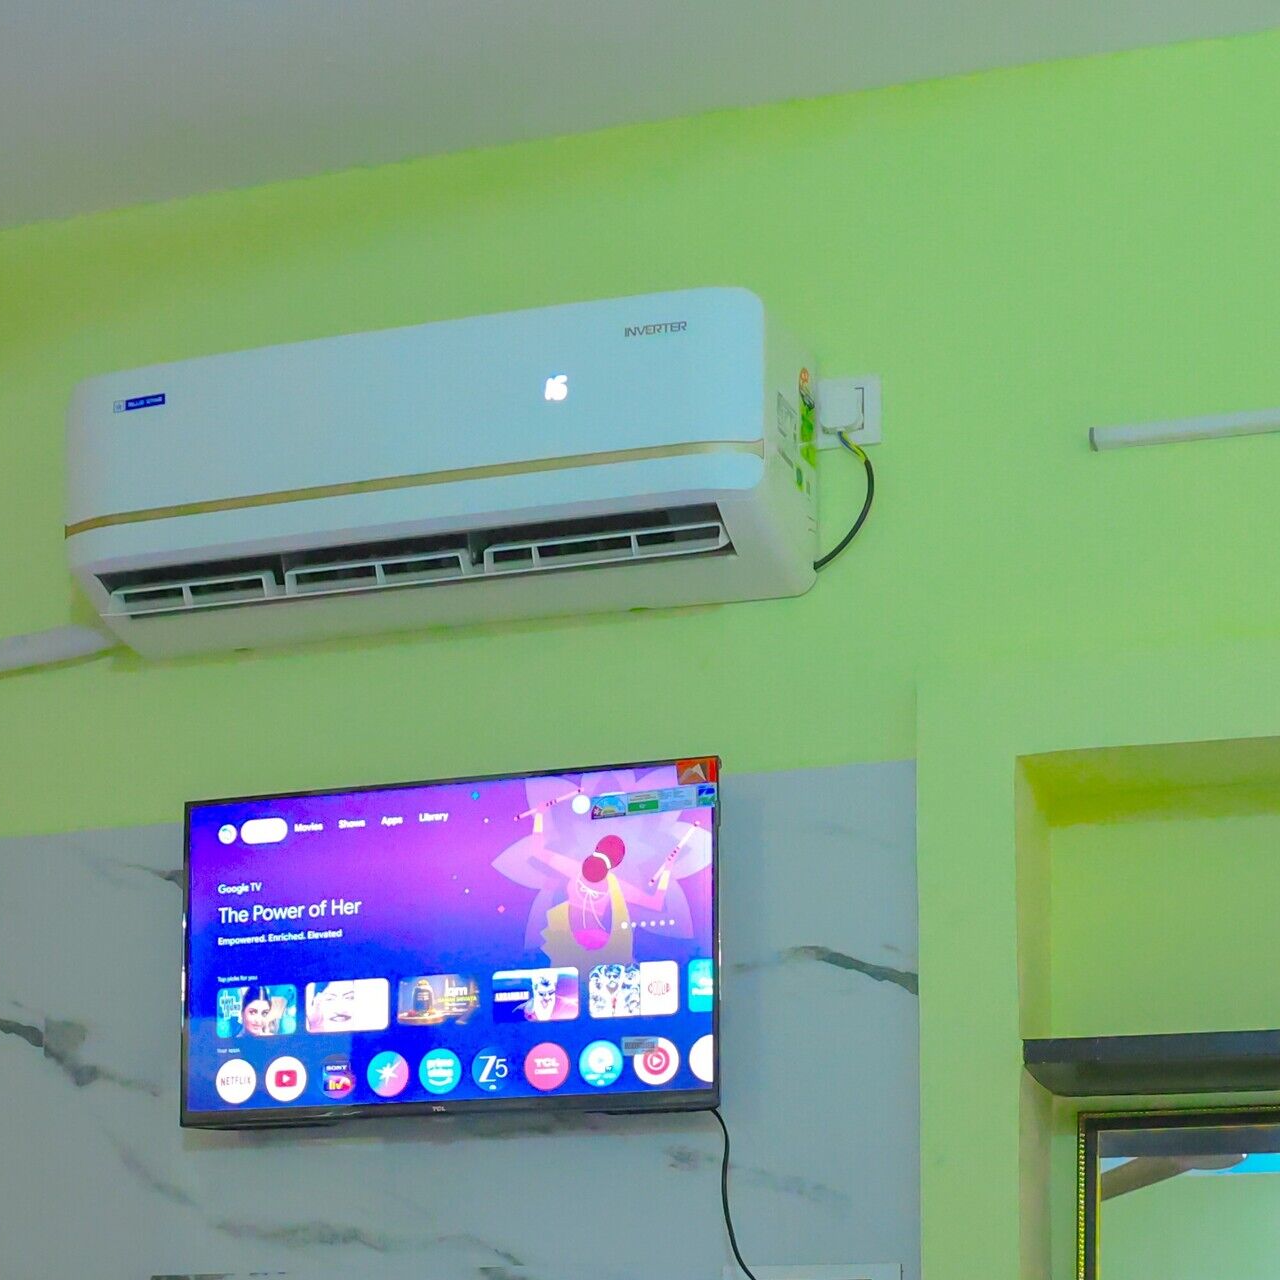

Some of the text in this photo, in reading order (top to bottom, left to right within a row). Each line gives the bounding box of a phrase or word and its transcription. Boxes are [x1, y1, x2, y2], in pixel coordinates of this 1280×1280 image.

[624, 320, 688, 338] INVERTER
[381, 815, 403, 827] Apps
[419, 812, 449, 823] Library
[294, 822, 324, 833] Movies
[338, 819, 366, 829] Shows
[218, 882, 262, 895] Google TV
[218, 898, 362, 924] The Power of Her
[218, 929, 343, 946] Empowered. Enriched. Elevated
[326, 1064, 348, 1072] SONY
[533, 1057, 559, 1068] TCL
[220, 1075, 252, 1087] NETFLIX
[432, 1105, 447, 1113] TCL
